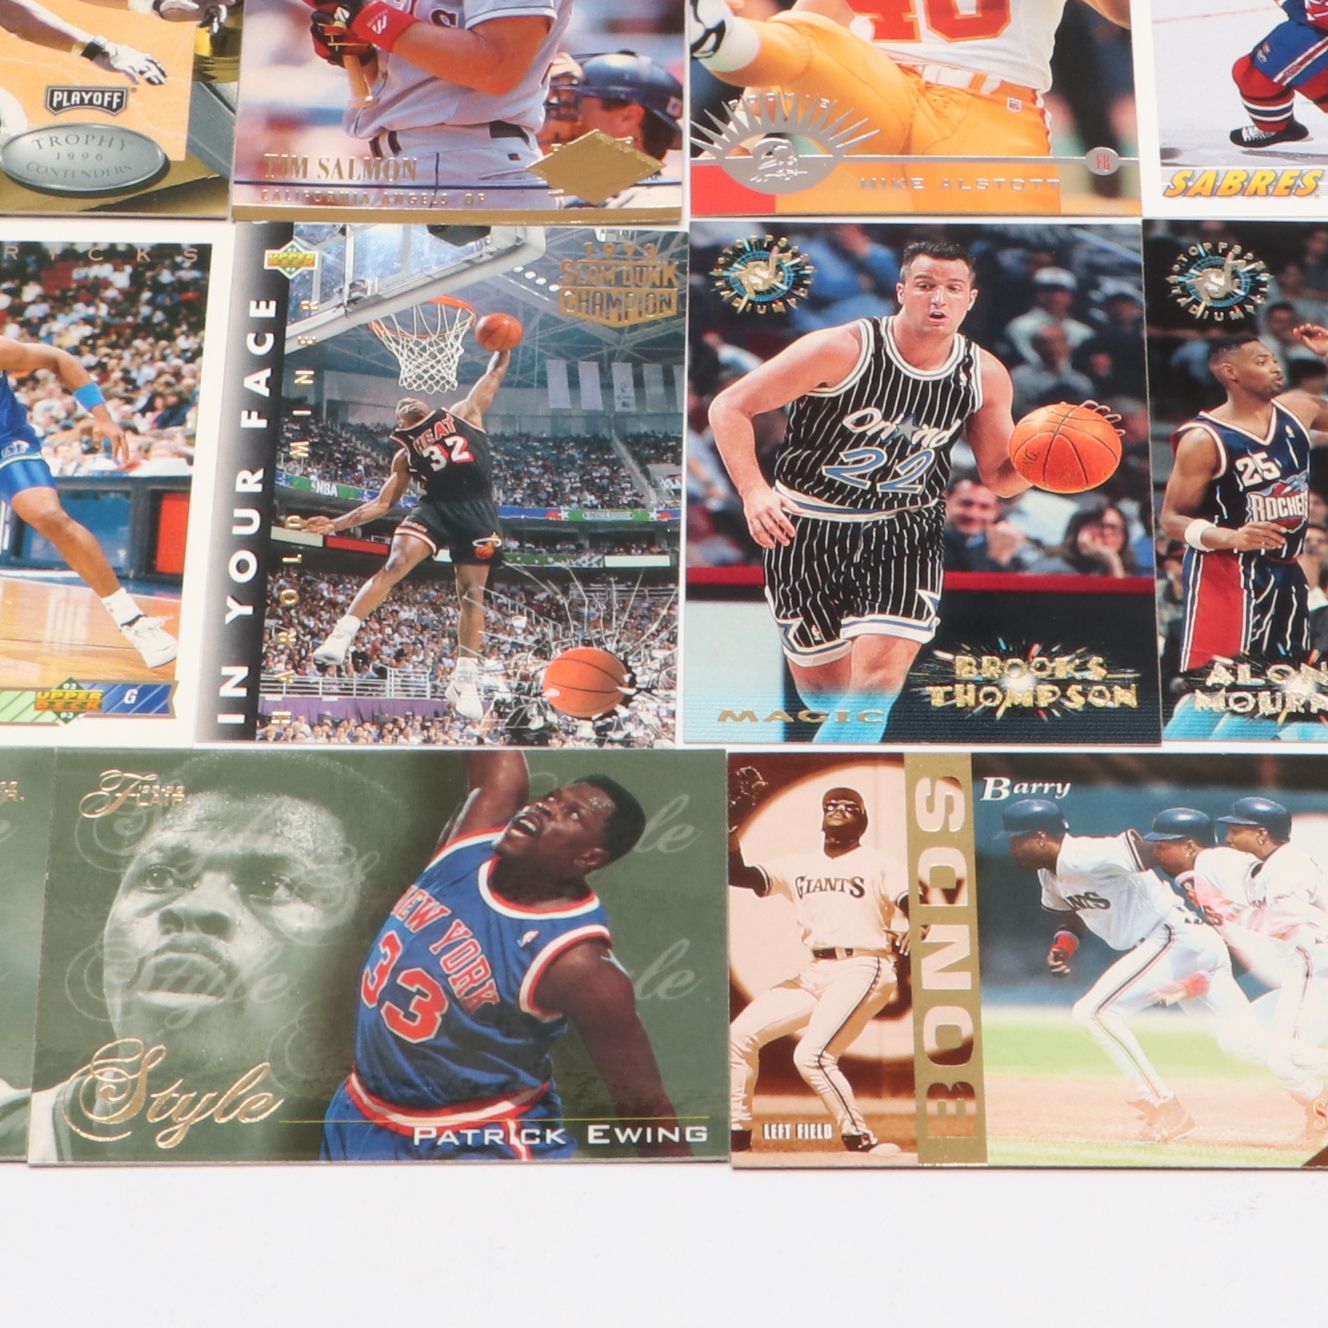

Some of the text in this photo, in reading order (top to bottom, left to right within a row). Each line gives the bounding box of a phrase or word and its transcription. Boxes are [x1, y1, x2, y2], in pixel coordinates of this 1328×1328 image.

[52, 90, 122, 110] PLAYOFF
[31, 133, 131, 152] TROPHY
[56, 152, 104, 162] 1996
[317, 155, 418, 183] SALMON
[858, 177, 1062, 191] MIKE ALSTOTT
[1162, 168, 1326, 200] SABRES
[422, 435, 474, 473] 32
[822, 447, 936, 496] 22
[1235, 453, 1275, 487] 25
[217, 297, 278, 726] IN YOUR FACE
[954, 654, 1109, 682] BROOKS
[35, 688, 138, 706] UPPER G
[926, 681, 1139, 710] THOMPSON
[716, 708, 889, 726] MAGIC
[980, 775, 1072, 803] Barry
[794, 873, 866, 901] GIANTS
[388, 883, 500, 1014] NEW YORK
[913, 775, 978, 1140] BONDS
[360, 930, 449, 1045] 33
[62, 1037, 285, 1150] Style
[412, 1123, 710, 1147] PATRICK EWING
[762, 1121, 833, 1141] LEFT FIELD
